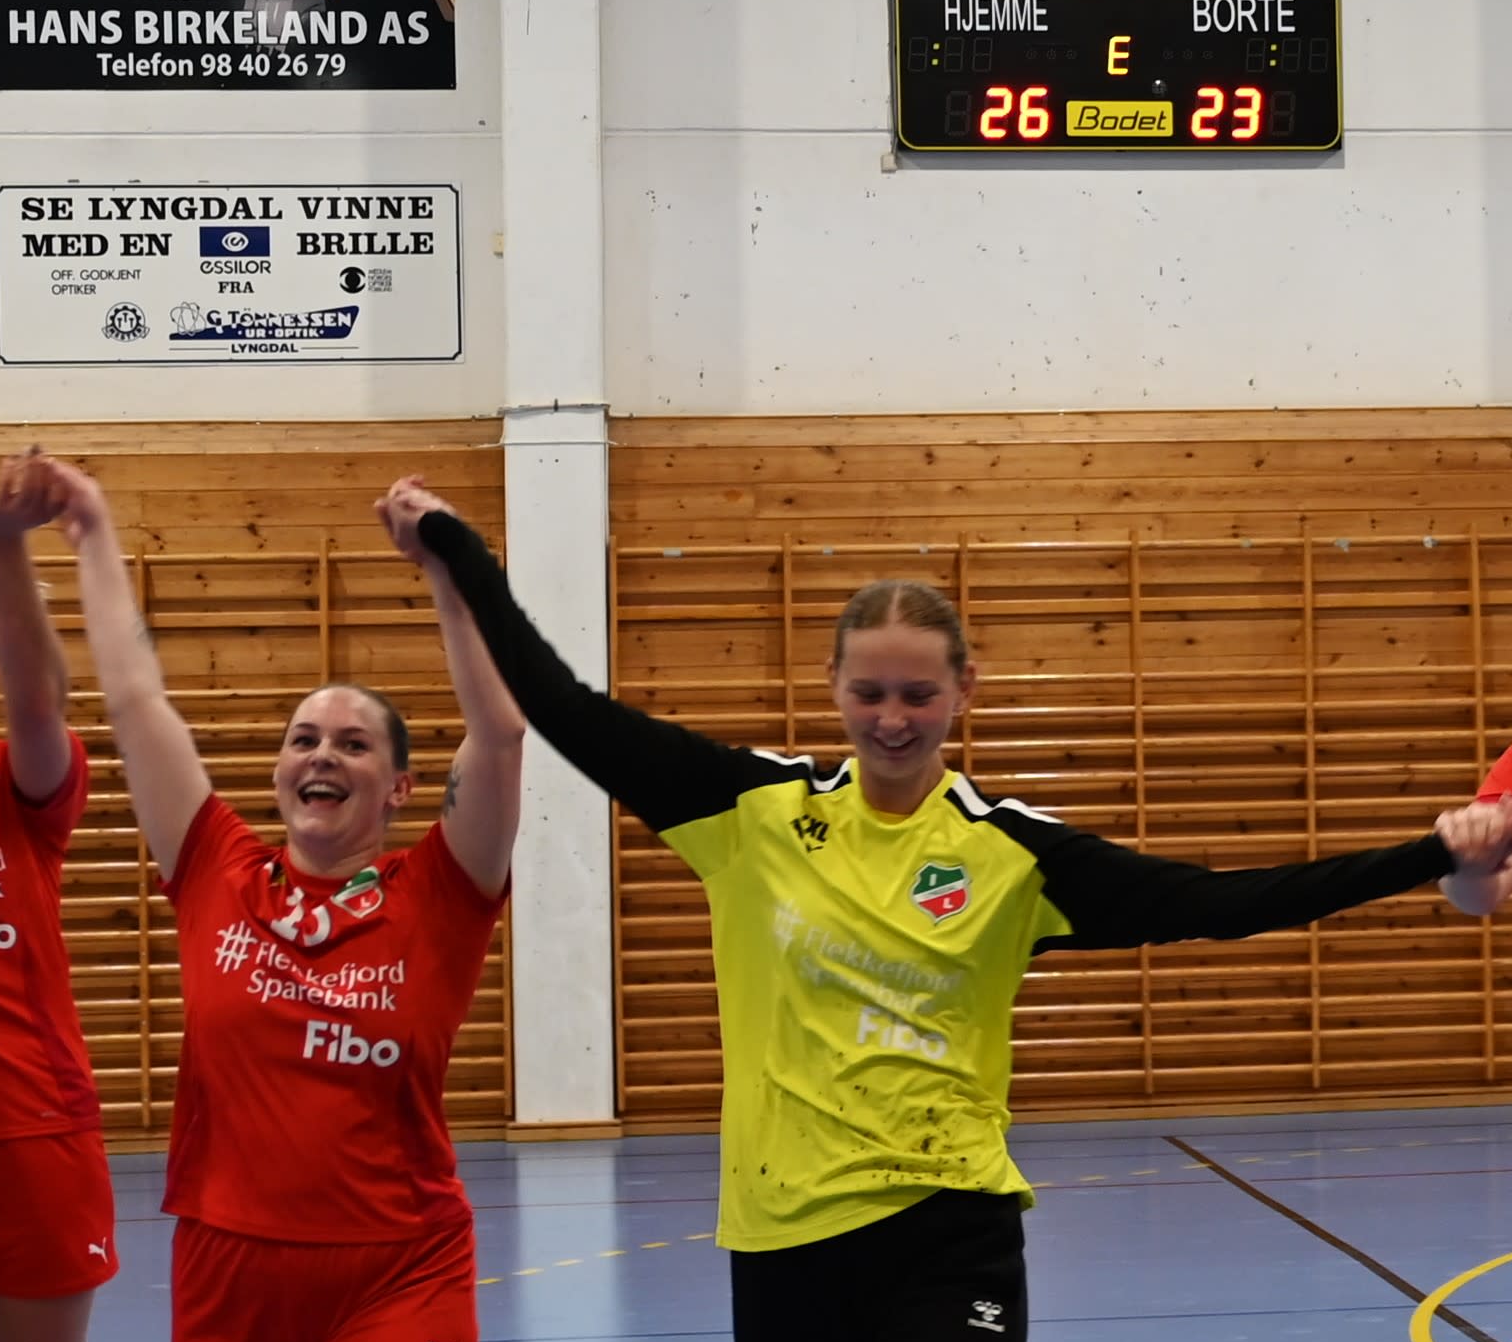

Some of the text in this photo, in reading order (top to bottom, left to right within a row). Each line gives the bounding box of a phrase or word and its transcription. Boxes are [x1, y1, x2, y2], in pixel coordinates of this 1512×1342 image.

[8, 10, 430, 45] HANS BIRKELAND AS
[96, 52, 346, 77] Telefon 98 40 26 79
[979, 87, 1050, 139] 26
[1074, 106, 1168, 131] Bodet
[1191, 87, 1261, 139] 23
[21, 196, 434, 221] SE LYNGDAL VINNE
[22, 232, 434, 257] MED EN BRILLE
[51, 269, 141, 281] OFF. GODKJENT
[218, 281, 254, 294] FRA
[51, 284, 97, 295] OPTIKER
[231, 344, 299, 353] LYNGDAL
[247, 969, 396, 1011] Sparebank
[303, 1020, 400, 1067] Fibo
